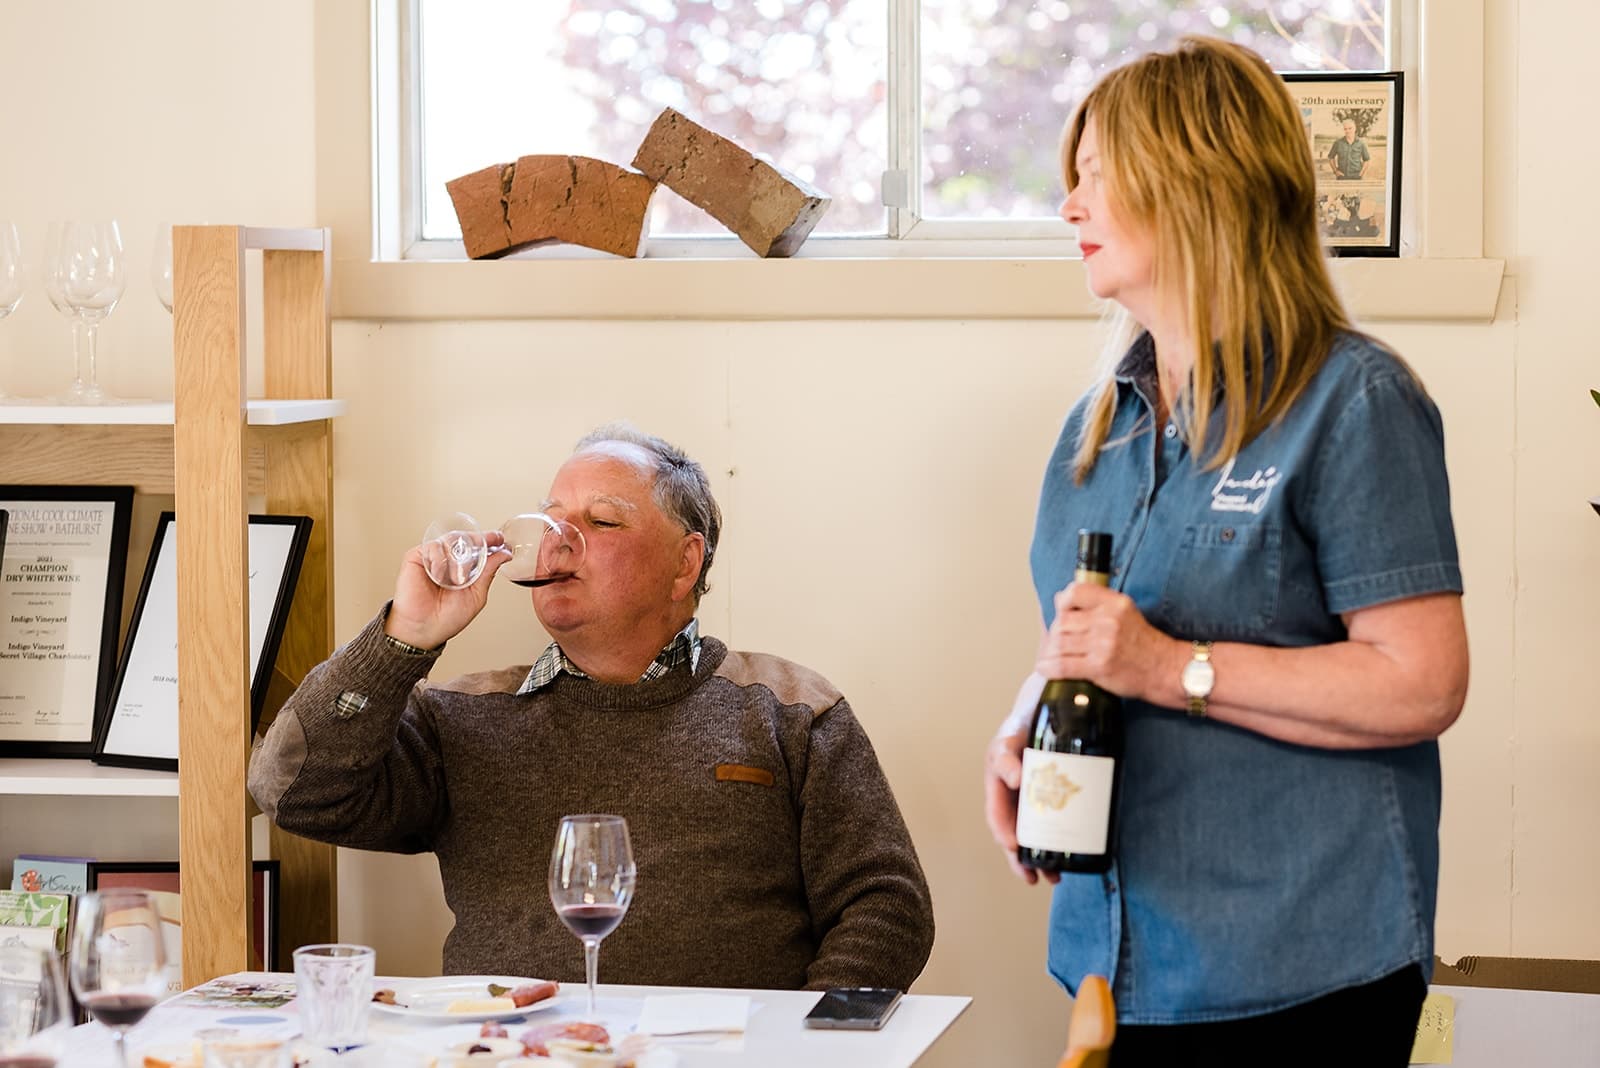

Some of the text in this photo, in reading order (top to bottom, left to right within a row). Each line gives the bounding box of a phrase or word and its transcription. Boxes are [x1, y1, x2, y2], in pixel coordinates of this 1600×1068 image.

[1301, 96, 1324, 105] 20th
[1326, 96, 1386, 107] anniversary
[9, 509, 104, 522] TIONAL COOL CLIMATE
[8, 522, 102, 536] NE SHOW BATHURST
[20, 564, 69, 573] CHAMPION
[5, 574, 81, 583] DRY WHITE WINE
[10, 615, 68, 624] Indigo Vineyard
[7, 642, 65, 652] Indigo Vineyard
[22, 652, 46, 661] Village
